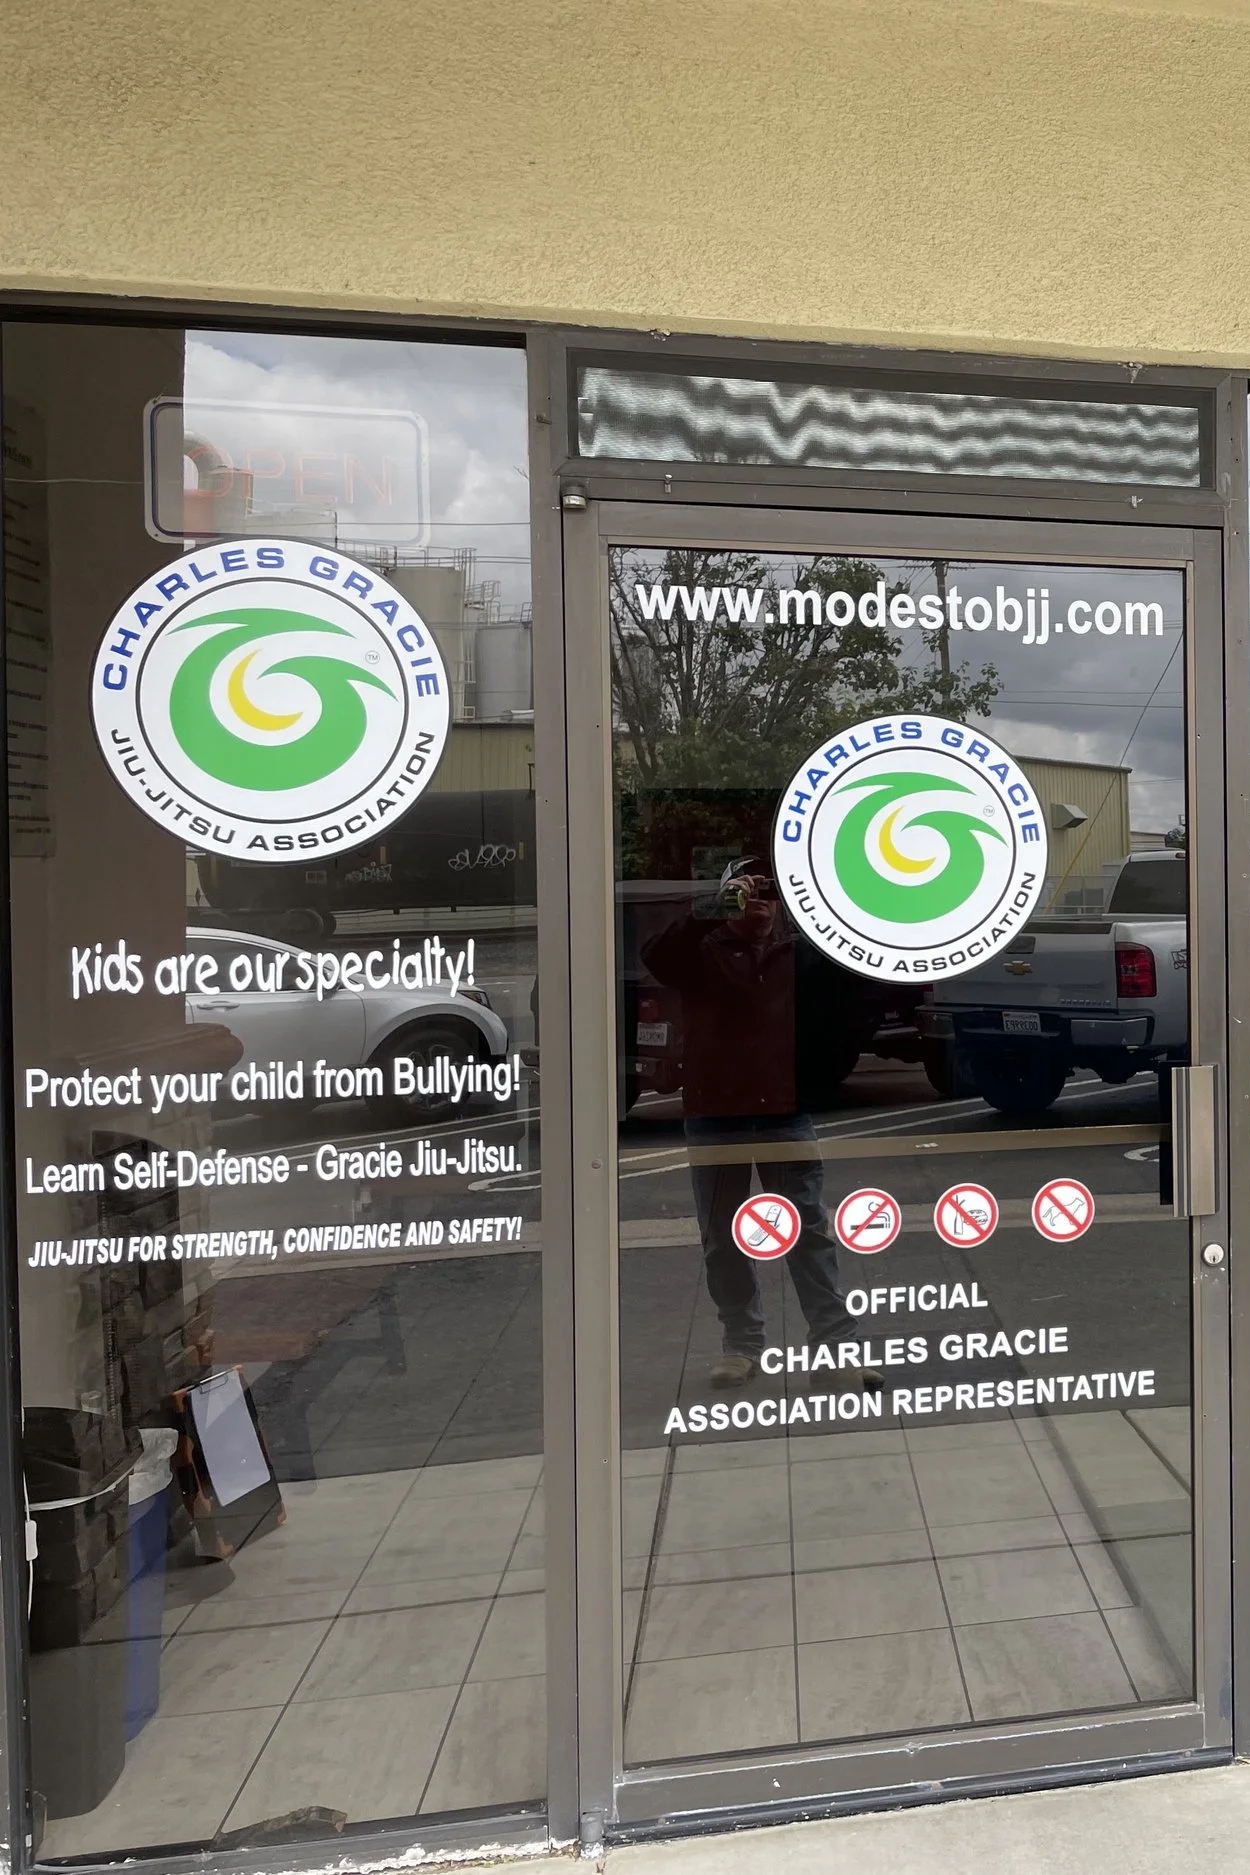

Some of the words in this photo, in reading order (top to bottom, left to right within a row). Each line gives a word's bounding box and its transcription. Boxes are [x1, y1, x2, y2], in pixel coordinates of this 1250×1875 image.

[188, 446, 393, 505] OPEN
[103, 547, 285, 691] CHARLES
[309, 556, 440, 698] GRACIE
[635, 582, 1164, 645] www.modestobjj.com
[111, 729, 237, 844] JIU-JITSU
[247, 731, 435, 851] ASSOCIATION
[782, 721, 923, 843] CHARLES
[941, 727, 1041, 844] GRACIE
[789, 873, 884, 969] JIU-JITSU
[892, 872, 1037, 974] ASSOCIATION
[71, 939, 144, 999] Kids
[155, 956, 219, 994] are
[230, 951, 290, 992] our
[296, 935, 475, 1001] specialty!
[26, 1067, 141, 1107] Protect
[151, 1070, 222, 1113] your
[231, 1060, 303, 1100] child
[313, 1059, 383, 1096] from
[394, 1054, 521, 1102] Bullying!
[26, 1157, 105, 1194] Learn
[113, 1149, 290, 1191] Self-Defense
[315, 1143, 402, 1181] Gracie
[410, 1138, 523, 1176] Jiu-Jitsu.
[28, 1236, 123, 1268] JIU-JITSU
[127, 1234, 168, 1262] FOR
[171, 1229, 279, 1261] STRENGTH,
[283, 1222, 402, 1254] CONFIDENCE
[406, 1220, 444, 1246] AND
[448, 1217, 522, 1243] SAFETY!
[845, 1282, 989, 1316] OFFICIAL
[759, 1337, 929, 1375] CHARLES
[938, 1326, 1069, 1364] GRACIE
[663, 1390, 882, 1436] ASSOCIATION
[892, 1370, 1156, 1416] REPRESENTATIVE
